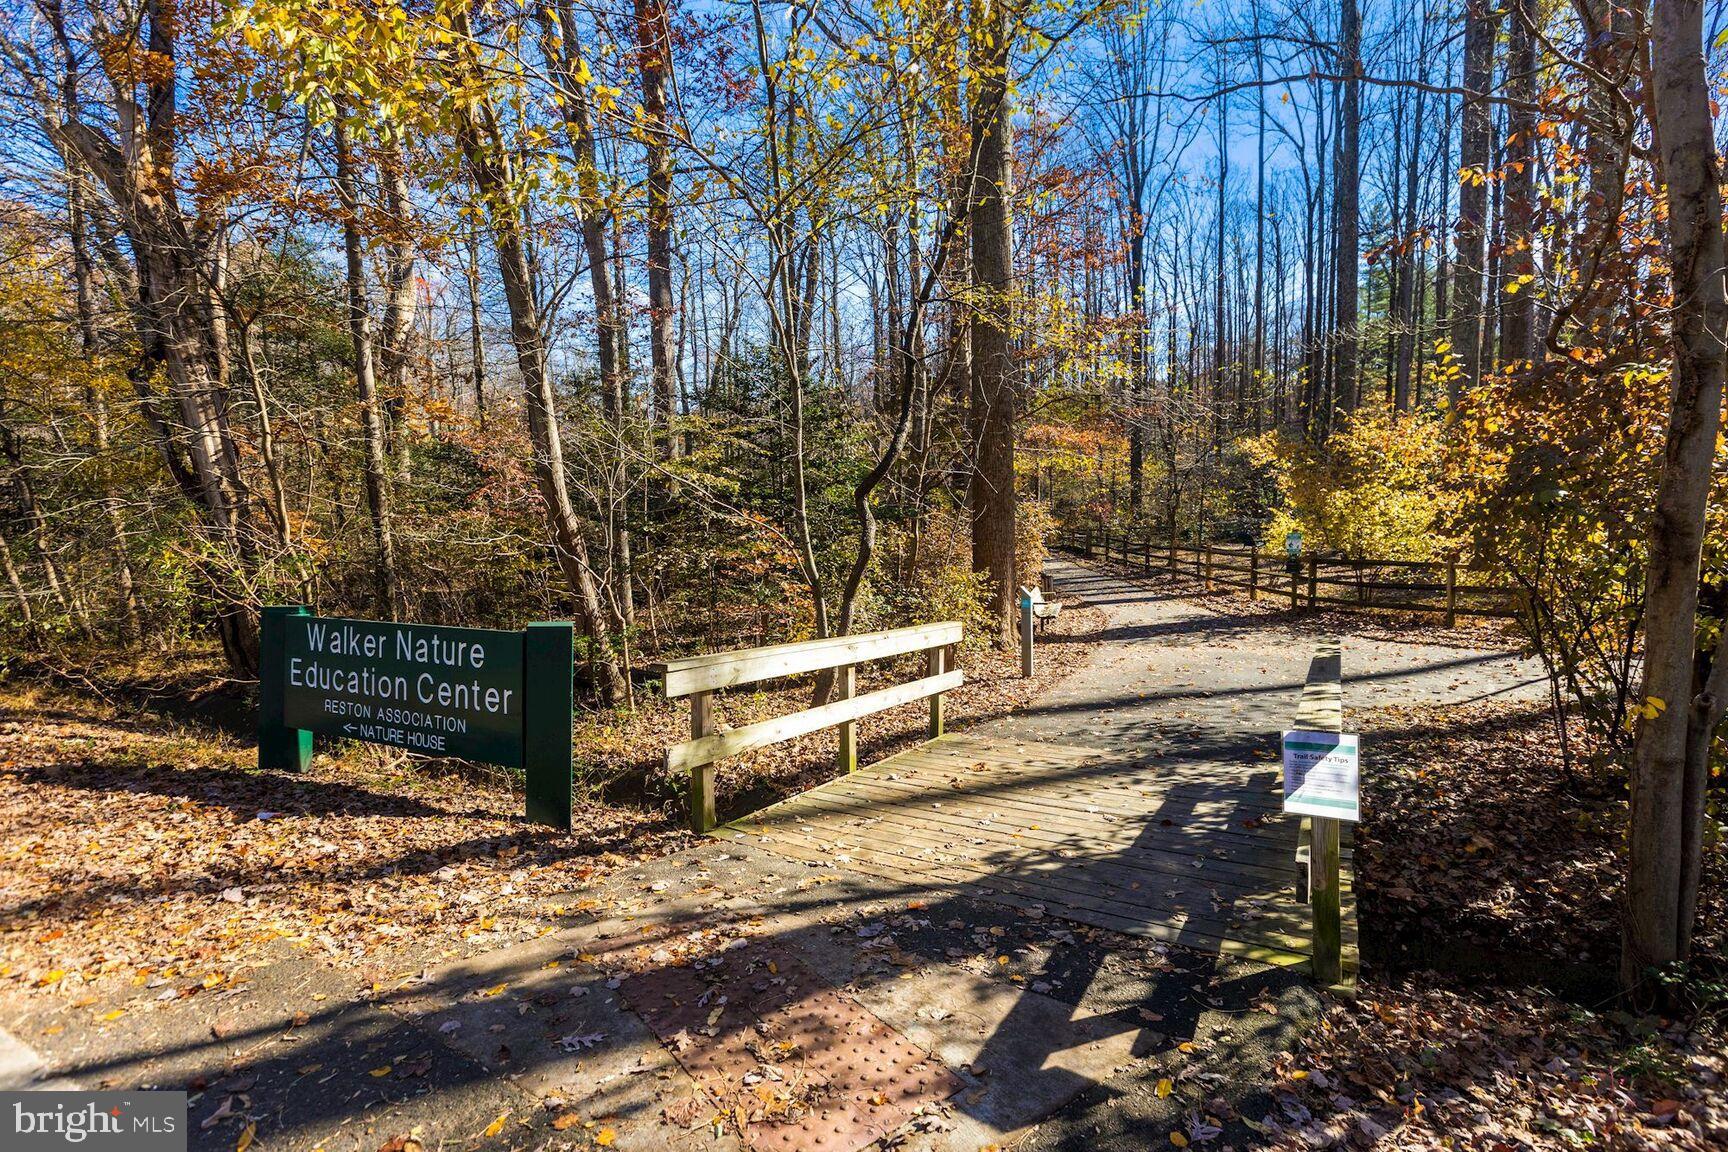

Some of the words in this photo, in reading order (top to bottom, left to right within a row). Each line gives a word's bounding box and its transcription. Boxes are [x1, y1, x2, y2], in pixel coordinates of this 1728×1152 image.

[307, 622, 386, 658] Walker
[396, 629, 485, 669] Nature
[290, 657, 407, 701] Education
[417, 672, 512, 714] Center
[324, 699, 371, 719] RESTON
[377, 706, 466, 733] ASSOCIATION
[360, 725, 404, 744] NATURE
[407, 732, 446, 751] HOUSE
[1310, 754, 1332, 762] Safety
